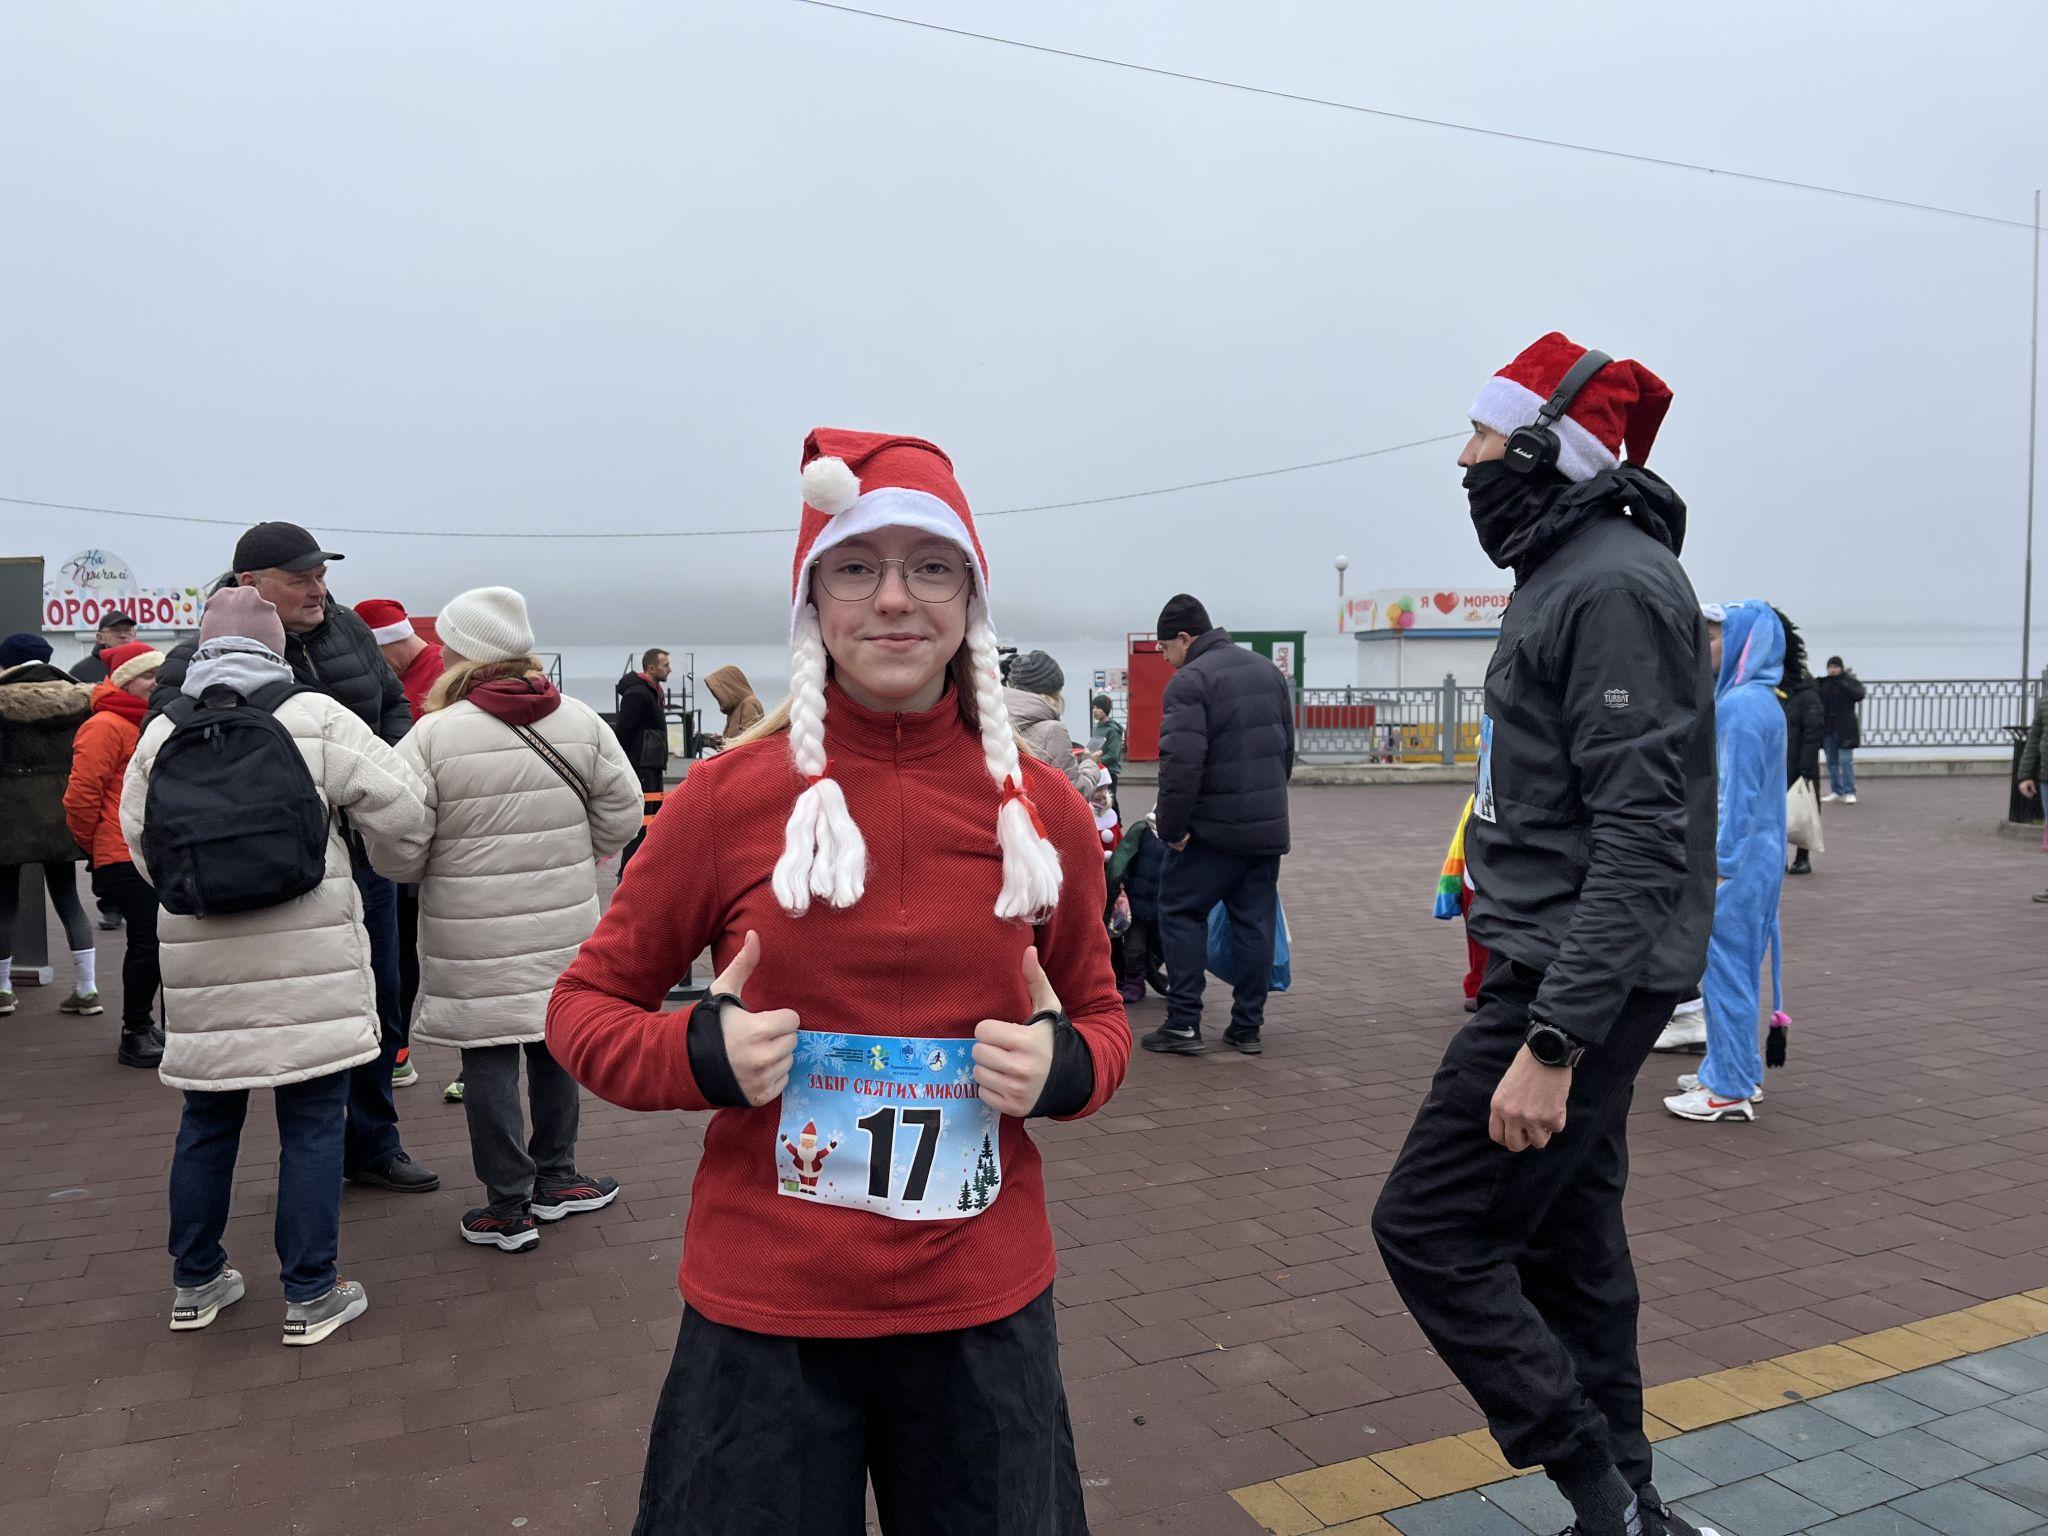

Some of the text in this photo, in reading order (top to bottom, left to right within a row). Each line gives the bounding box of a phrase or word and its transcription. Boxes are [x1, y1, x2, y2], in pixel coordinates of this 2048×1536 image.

[41, 597, 174, 626] ОРОЗИВО
[1421, 596, 1429, 608] Я
[807, 1073, 848, 1091] ЗАБІГ
[853, 1078, 918, 1099] СВЯТИХ
[856, 1106, 942, 1201] 17
